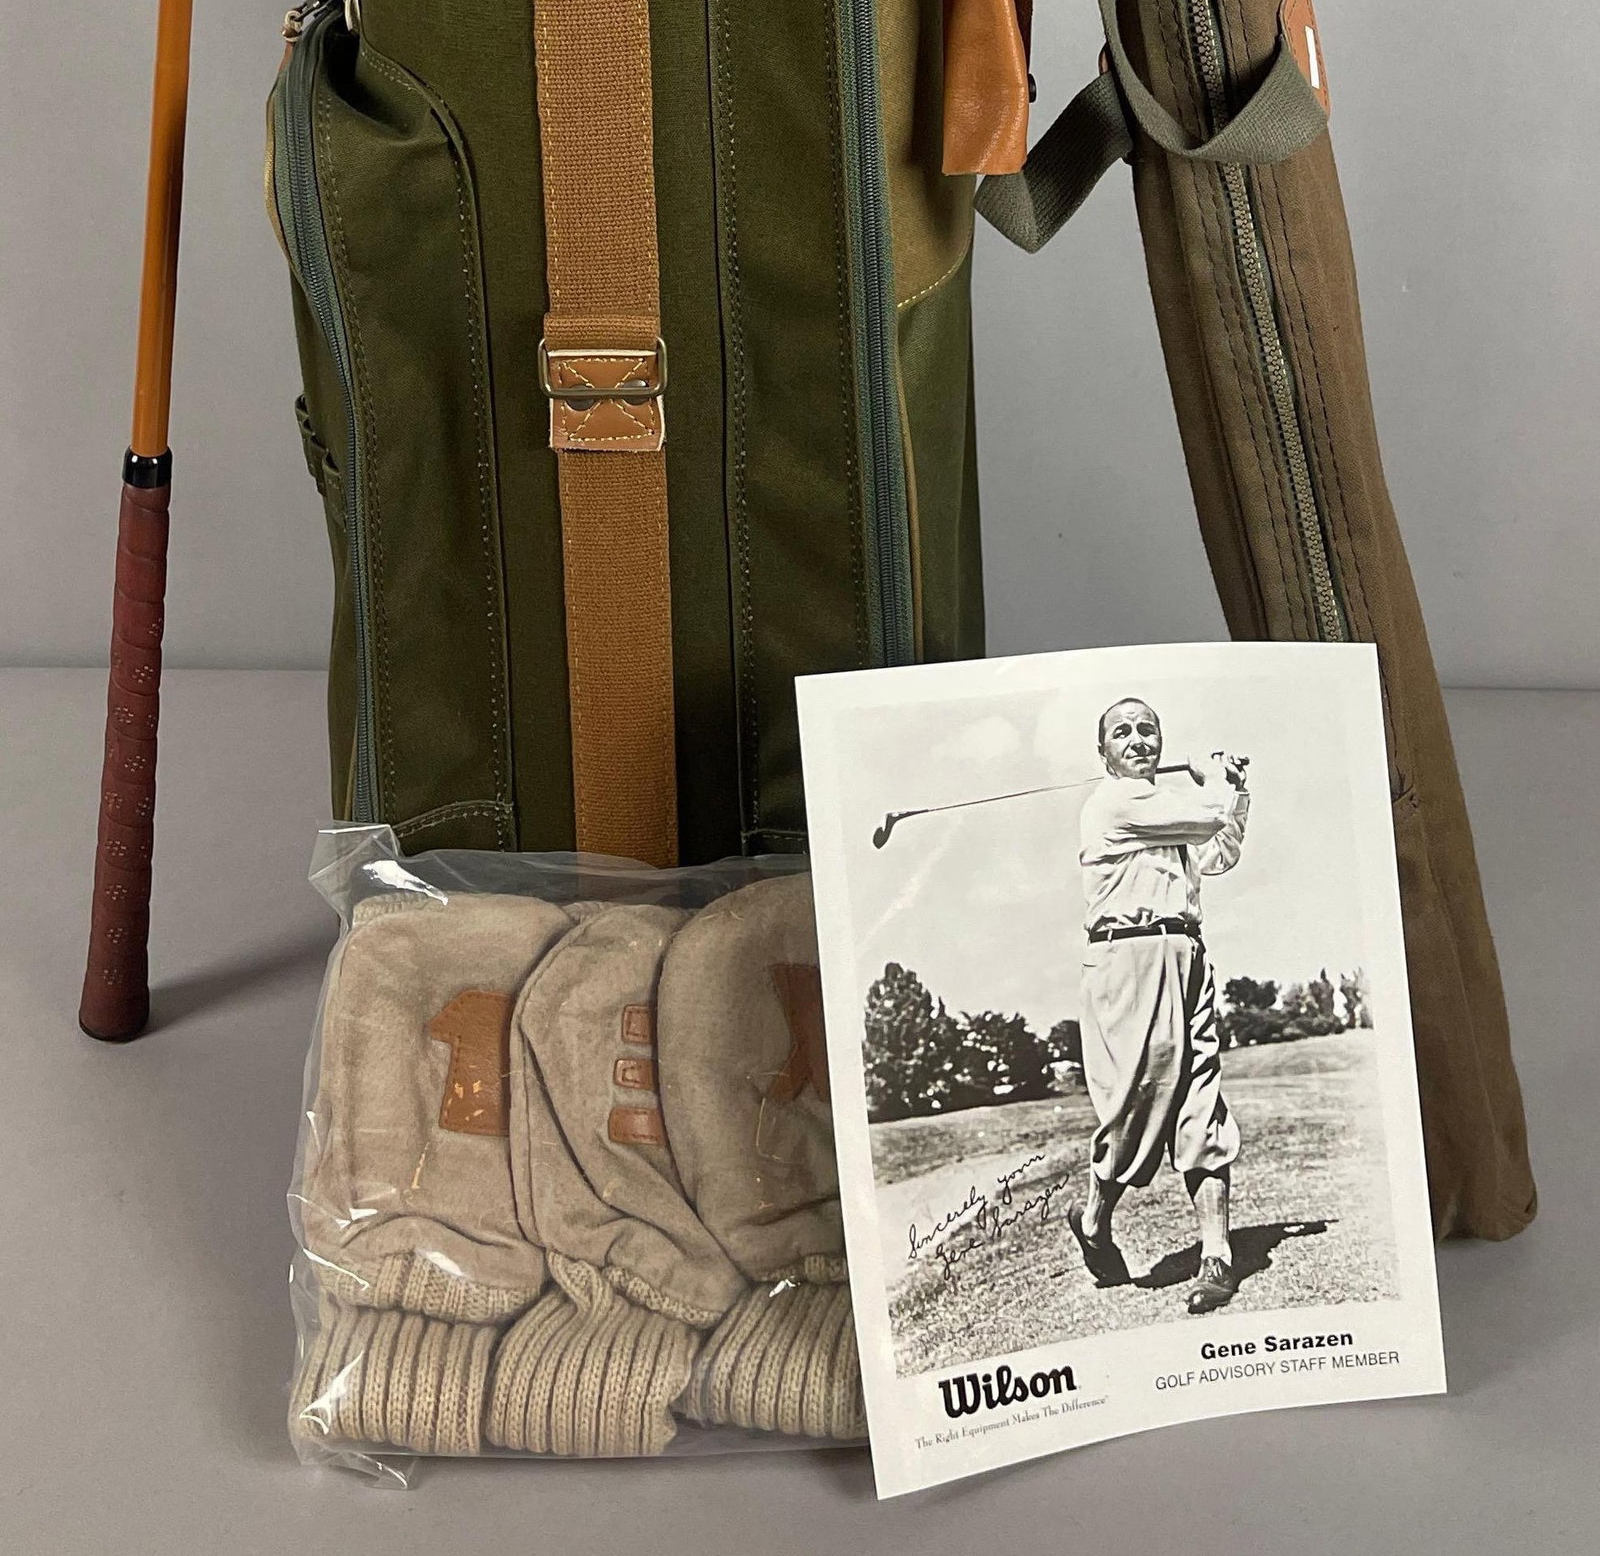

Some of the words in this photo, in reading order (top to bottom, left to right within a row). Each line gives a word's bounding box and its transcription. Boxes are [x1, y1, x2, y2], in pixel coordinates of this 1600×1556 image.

[908, 1185, 988, 1260] Sincerely
[1155, 1371, 1195, 1390] GOLF
[1199, 1361, 1276, 1384] ADVISORY
[1280, 1356, 1327, 1374] STAFF
[1332, 1350, 1400, 1369] MEMBER
[1201, 1341, 1257, 1360] Gene
[1264, 1332, 1354, 1353] Sarazen
[938, 1364, 1078, 1419] Wilson
[915, 1435, 933, 1449] The
[935, 1428, 960, 1444] Right
[961, 1418, 1011, 1438] Equipment
[1011, 1409, 1041, 1424] Makes
[1041, 1404, 1060, 1418] The
[1061, 1397, 1106, 1414] Difference
